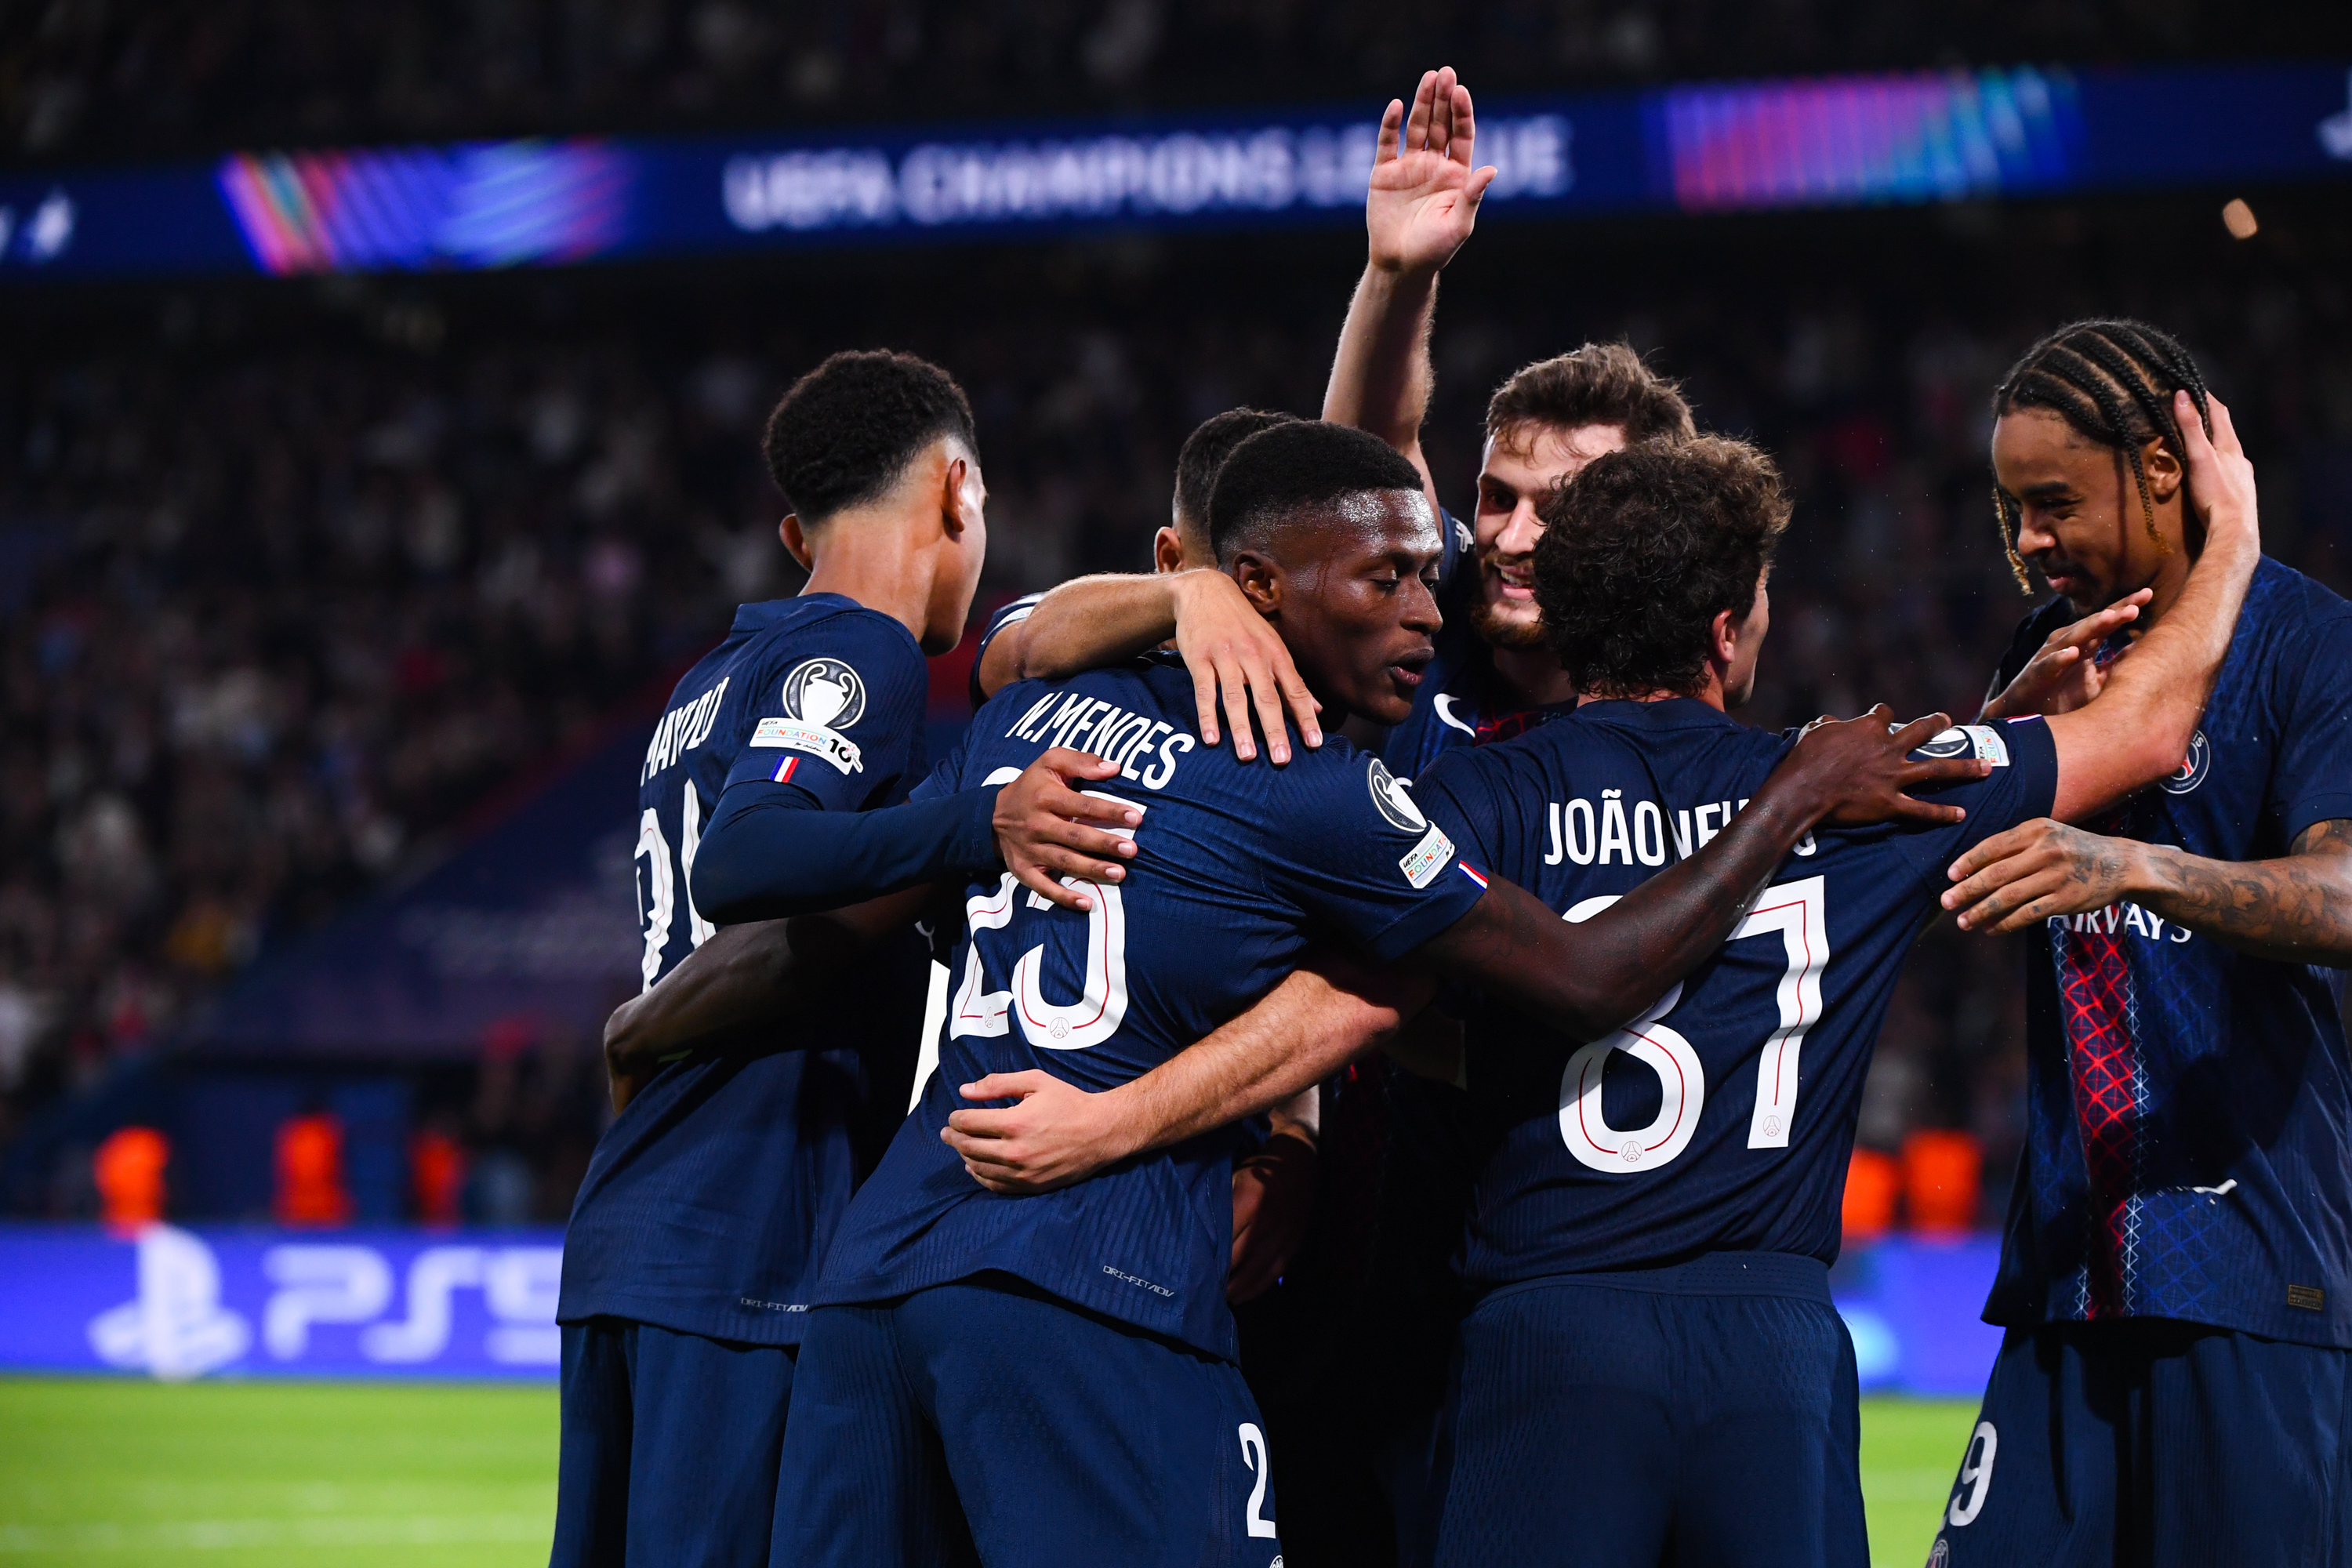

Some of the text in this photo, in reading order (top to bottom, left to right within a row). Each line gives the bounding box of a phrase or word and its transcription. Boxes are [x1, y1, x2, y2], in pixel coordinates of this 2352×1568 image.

[723, 114, 1570, 230] UEFA CHAMPIONS LEUE
[757, 728, 827, 746] FOUNDATION
[1004, 691, 1196, 790] N.MENDES
[1403, 852, 1418, 869] UEFA
[1544, 788, 1666, 867] JOÃO
